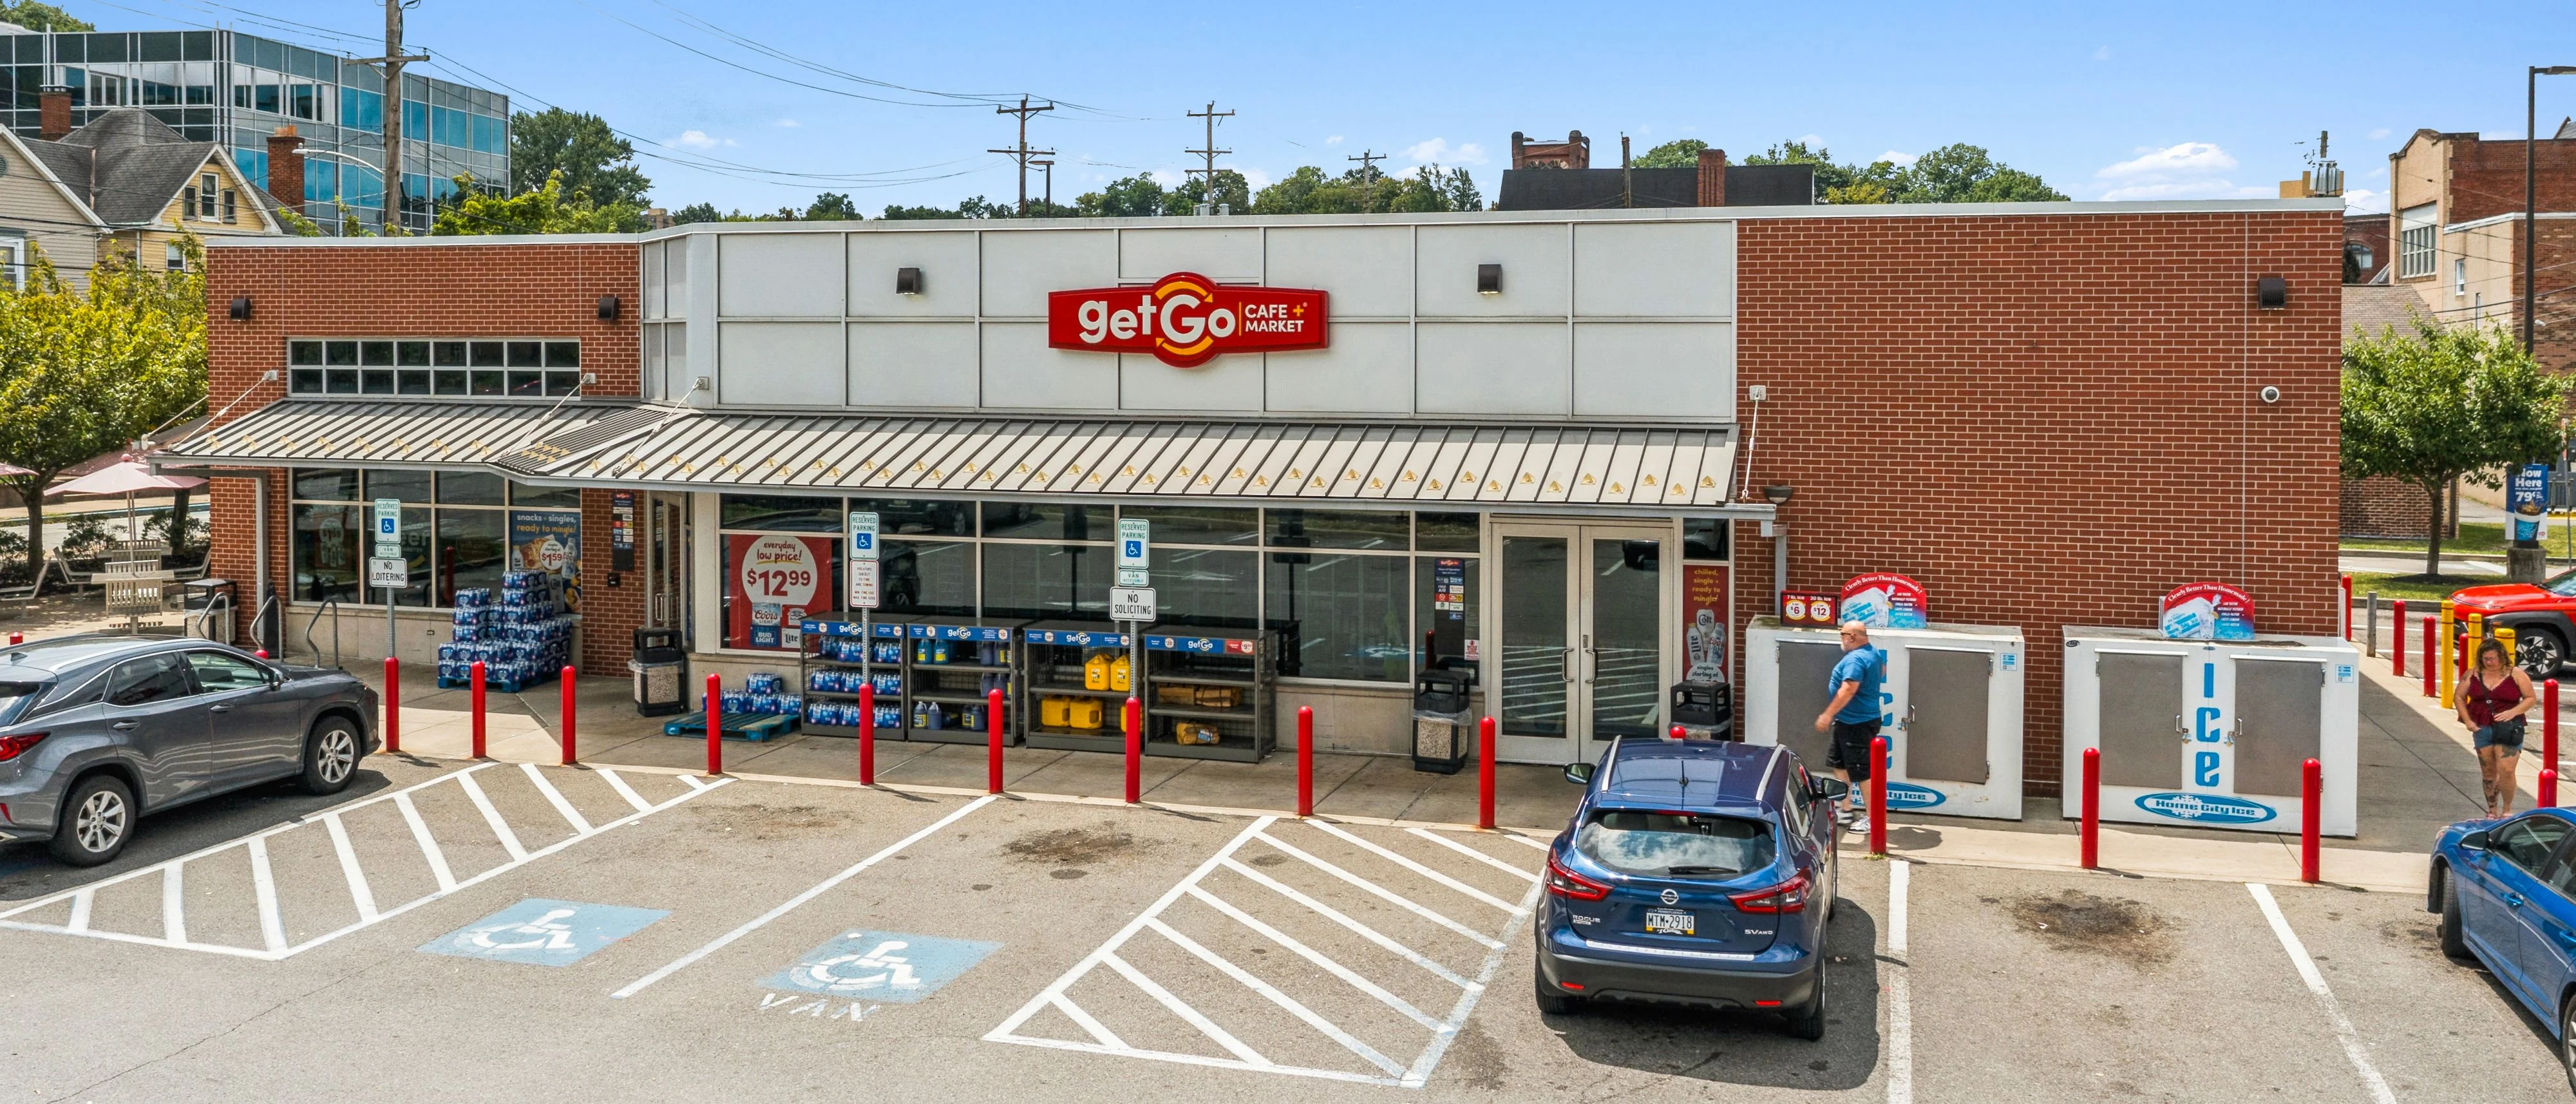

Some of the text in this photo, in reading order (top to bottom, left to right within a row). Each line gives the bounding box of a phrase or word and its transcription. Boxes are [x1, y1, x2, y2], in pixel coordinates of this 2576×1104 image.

[1245, 305, 1287, 318] CAFE
[1078, 294, 1236, 344] getGo
[1245, 320, 1303, 332] MARKET
[2515, 478, 2543, 487] Here
[549, 515, 577, 524] singles,
[517, 524, 540, 533] ready
[764, 540, 796, 552] everyday
[757, 549, 802, 564] low price!
[384, 562, 393, 570] NO
[1845, 579, 1862, 591] Clearly
[1128, 594, 1138, 603] NO
[1694, 595, 1718, 605] mingle!
[2168, 589, 2186, 601] Clearly
[1115, 604, 1151, 614] SOLICITING
[1814, 607, 1826, 616] $12
[755, 609, 778, 620] Coors
[1698, 614, 1713, 626] Colt
[839, 624, 862, 634] getGo
[947, 629, 971, 637] getGo
[786, 633, 799, 643] Lite
[1066, 634, 1091, 642] getGo
[1188, 640, 1213, 649] getGo
[1692, 671, 1712, 680] starting
[2155, 799, 2255, 815] Home City Ice
[759, 993, 881, 1022] VAN
